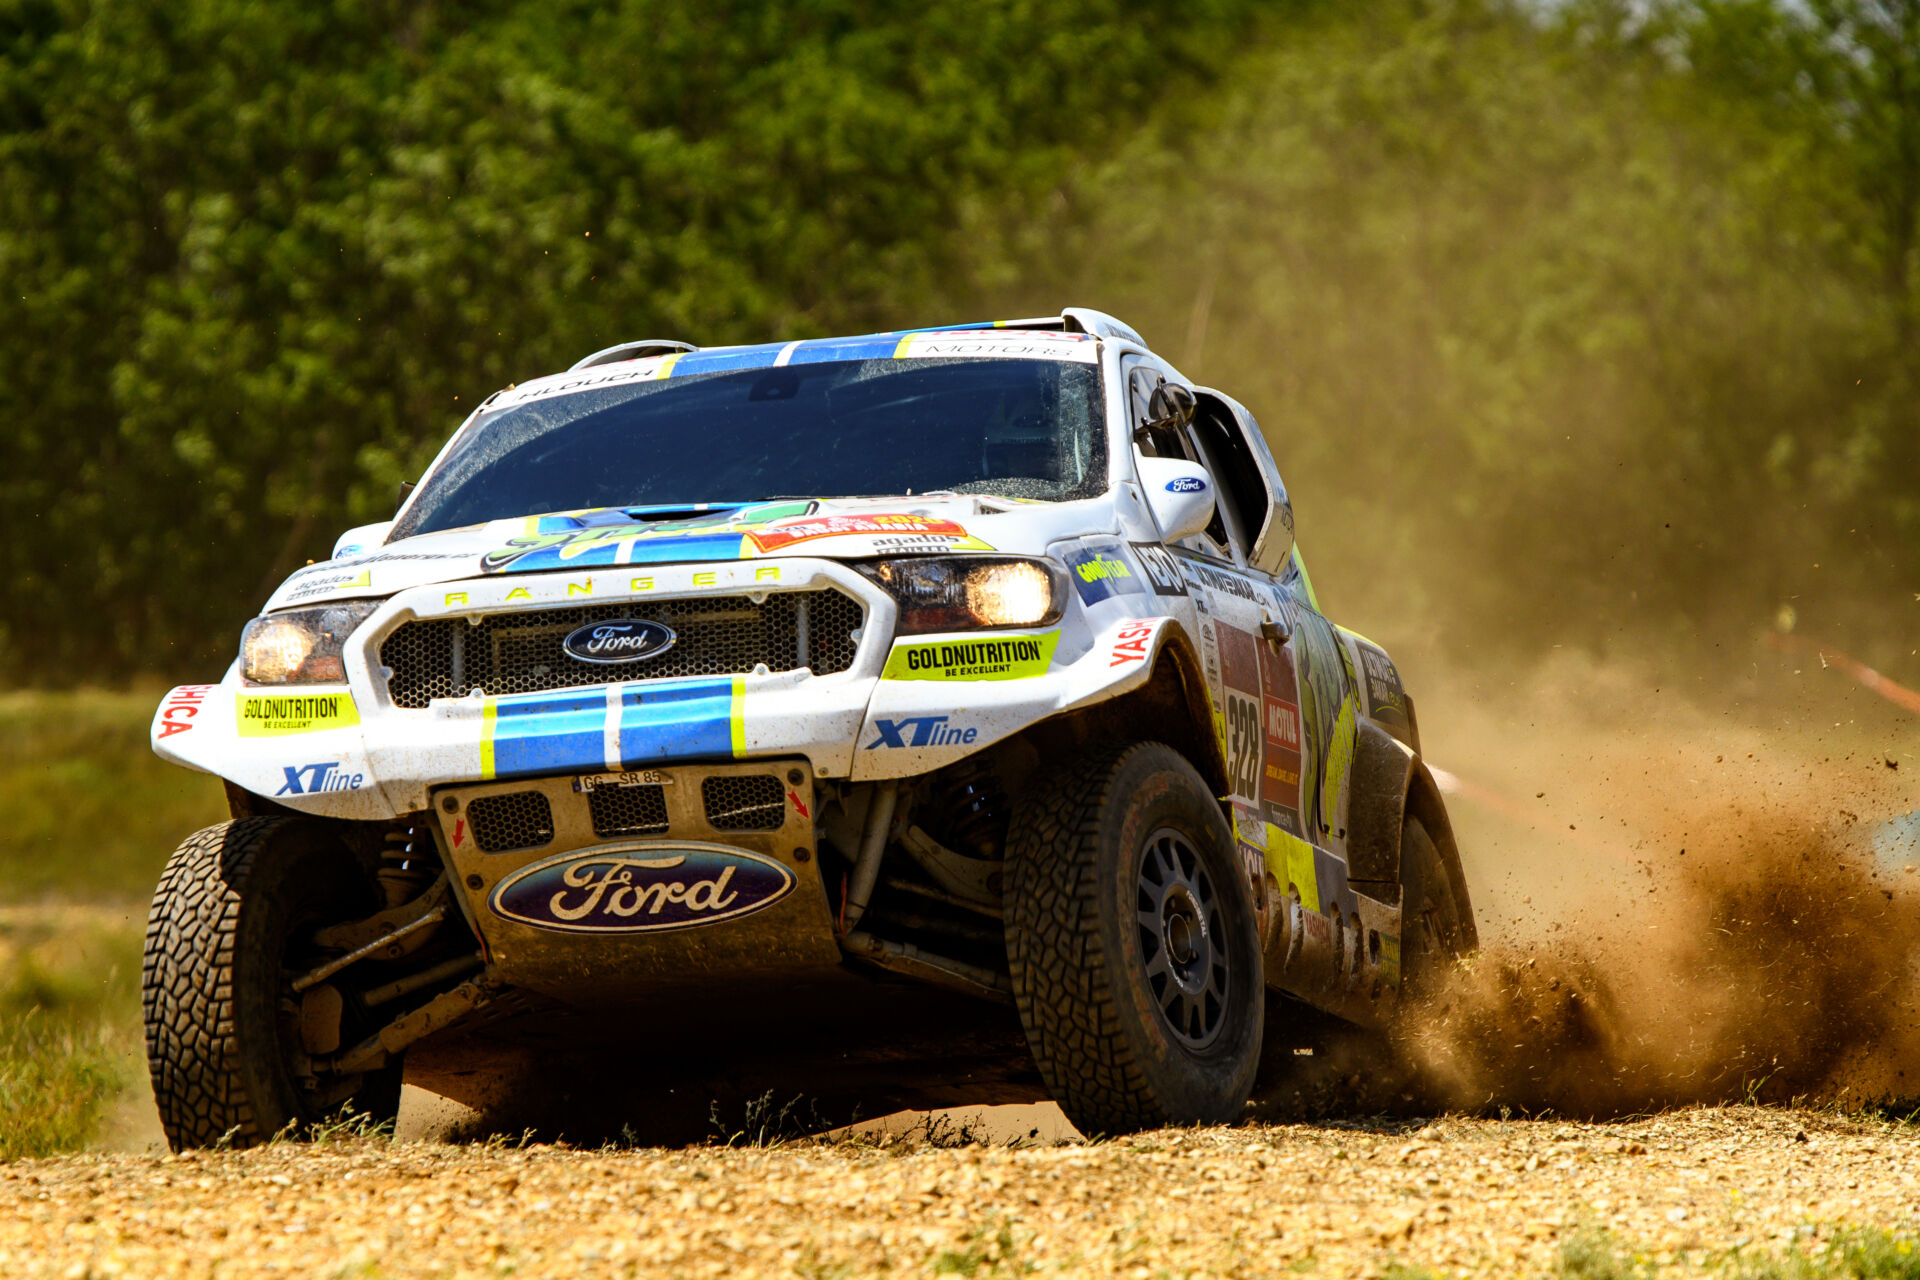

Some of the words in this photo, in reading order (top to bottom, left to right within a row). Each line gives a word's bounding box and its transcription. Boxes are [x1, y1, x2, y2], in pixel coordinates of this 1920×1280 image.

[926, 345, 1072, 356] MOTORS
[519, 369, 653, 400] HLOUCH
[1173, 477, 1201, 492] Ford
[871, 534, 960, 547] agados
[1076, 554, 1131, 584] GOODYEAR
[445, 566, 781, 607] RANGER
[587, 625, 648, 654] Ford
[907, 640, 1041, 671] GOLDNUTRITION
[945, 669, 957, 677] BE
[960, 664, 1011, 676] EXCELLENT
[244, 697, 338, 719] GOLDNUTRITION
[264, 721, 272, 729] BE
[273, 720, 312, 729] EXCELLENT
[864, 716, 978, 750] XTline
[1268, 703, 1298, 744] MOTUL
[1228, 694, 1259, 802] 328
[275, 762, 364, 797] XTline
[620, 772, 640, 785] SR
[643, 771, 661, 784] 85
[550, 855, 739, 920] Ford
